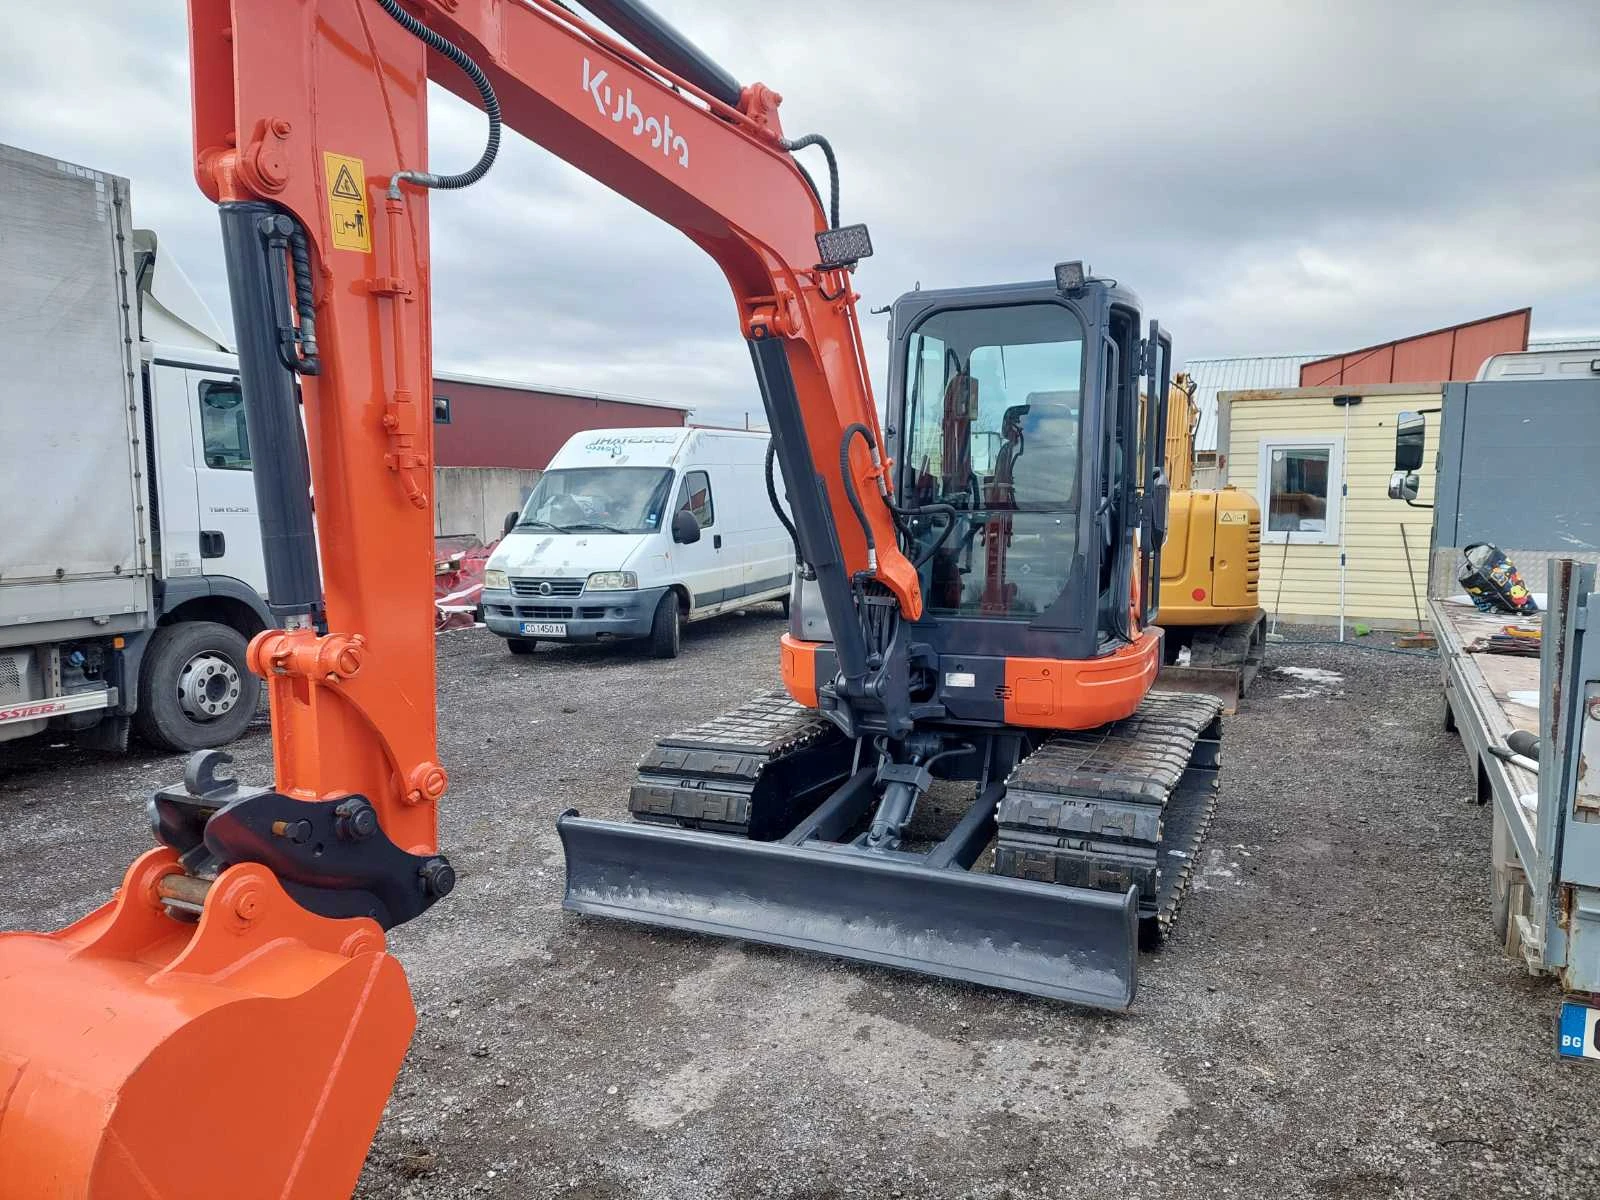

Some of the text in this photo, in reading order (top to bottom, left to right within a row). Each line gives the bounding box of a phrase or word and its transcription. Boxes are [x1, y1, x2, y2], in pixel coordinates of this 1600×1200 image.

[582, 57, 689, 169] Kubota
[537, 624, 554, 633] 1450
[1562, 1034, 1582, 1048] BG
